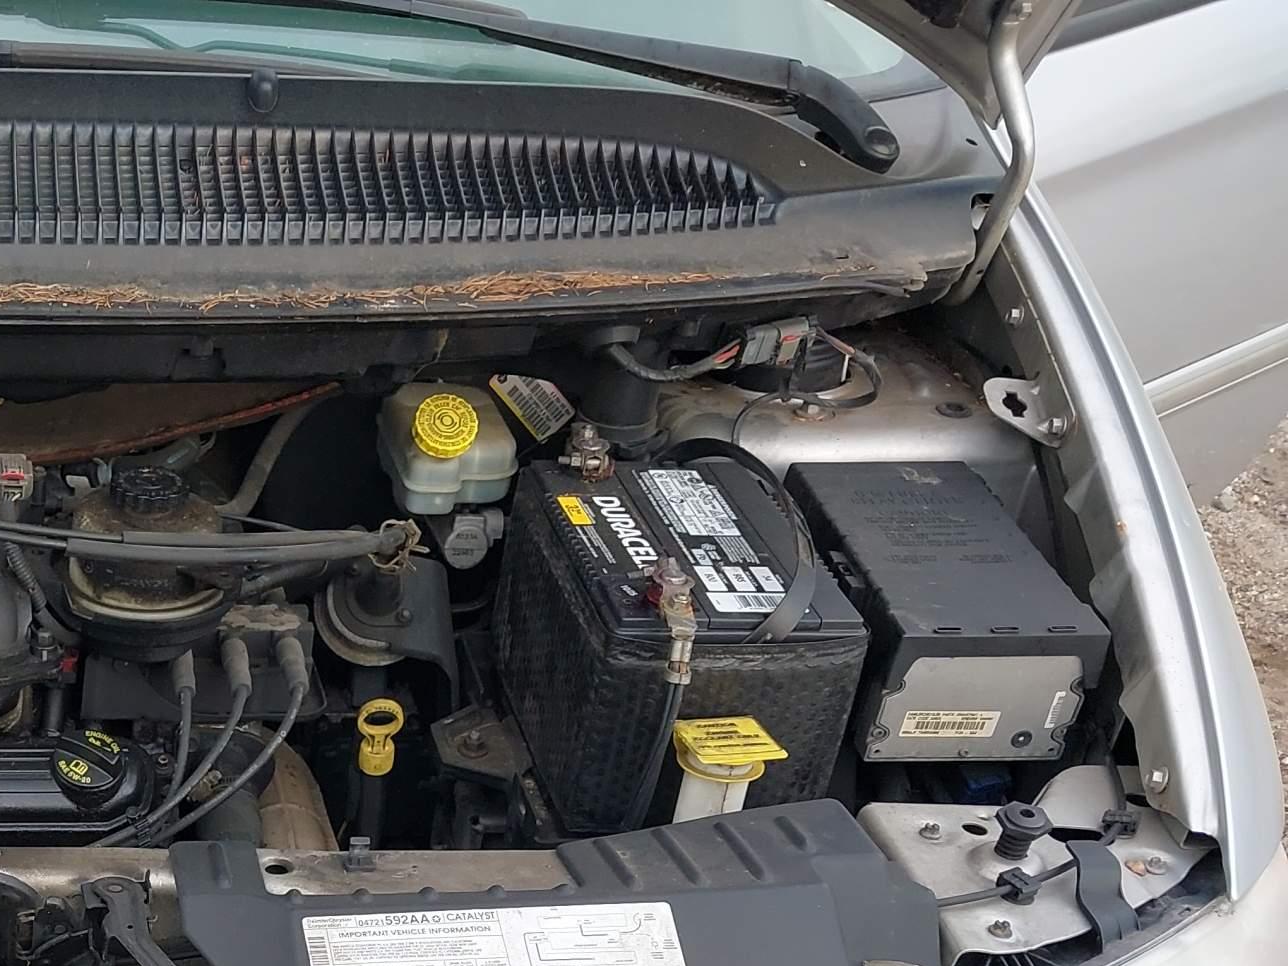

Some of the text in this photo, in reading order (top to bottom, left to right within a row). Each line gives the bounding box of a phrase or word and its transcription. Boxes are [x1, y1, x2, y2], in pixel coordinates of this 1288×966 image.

[592, 496, 659, 571] DURACEL
[85, 730, 121, 754] ENGINE OIL
[58, 760, 70, 774] SAE
[446, 912, 495, 921] CATALYST
[338, 926, 491, 939] IMPORTANT VEHICLE INFORMATION
